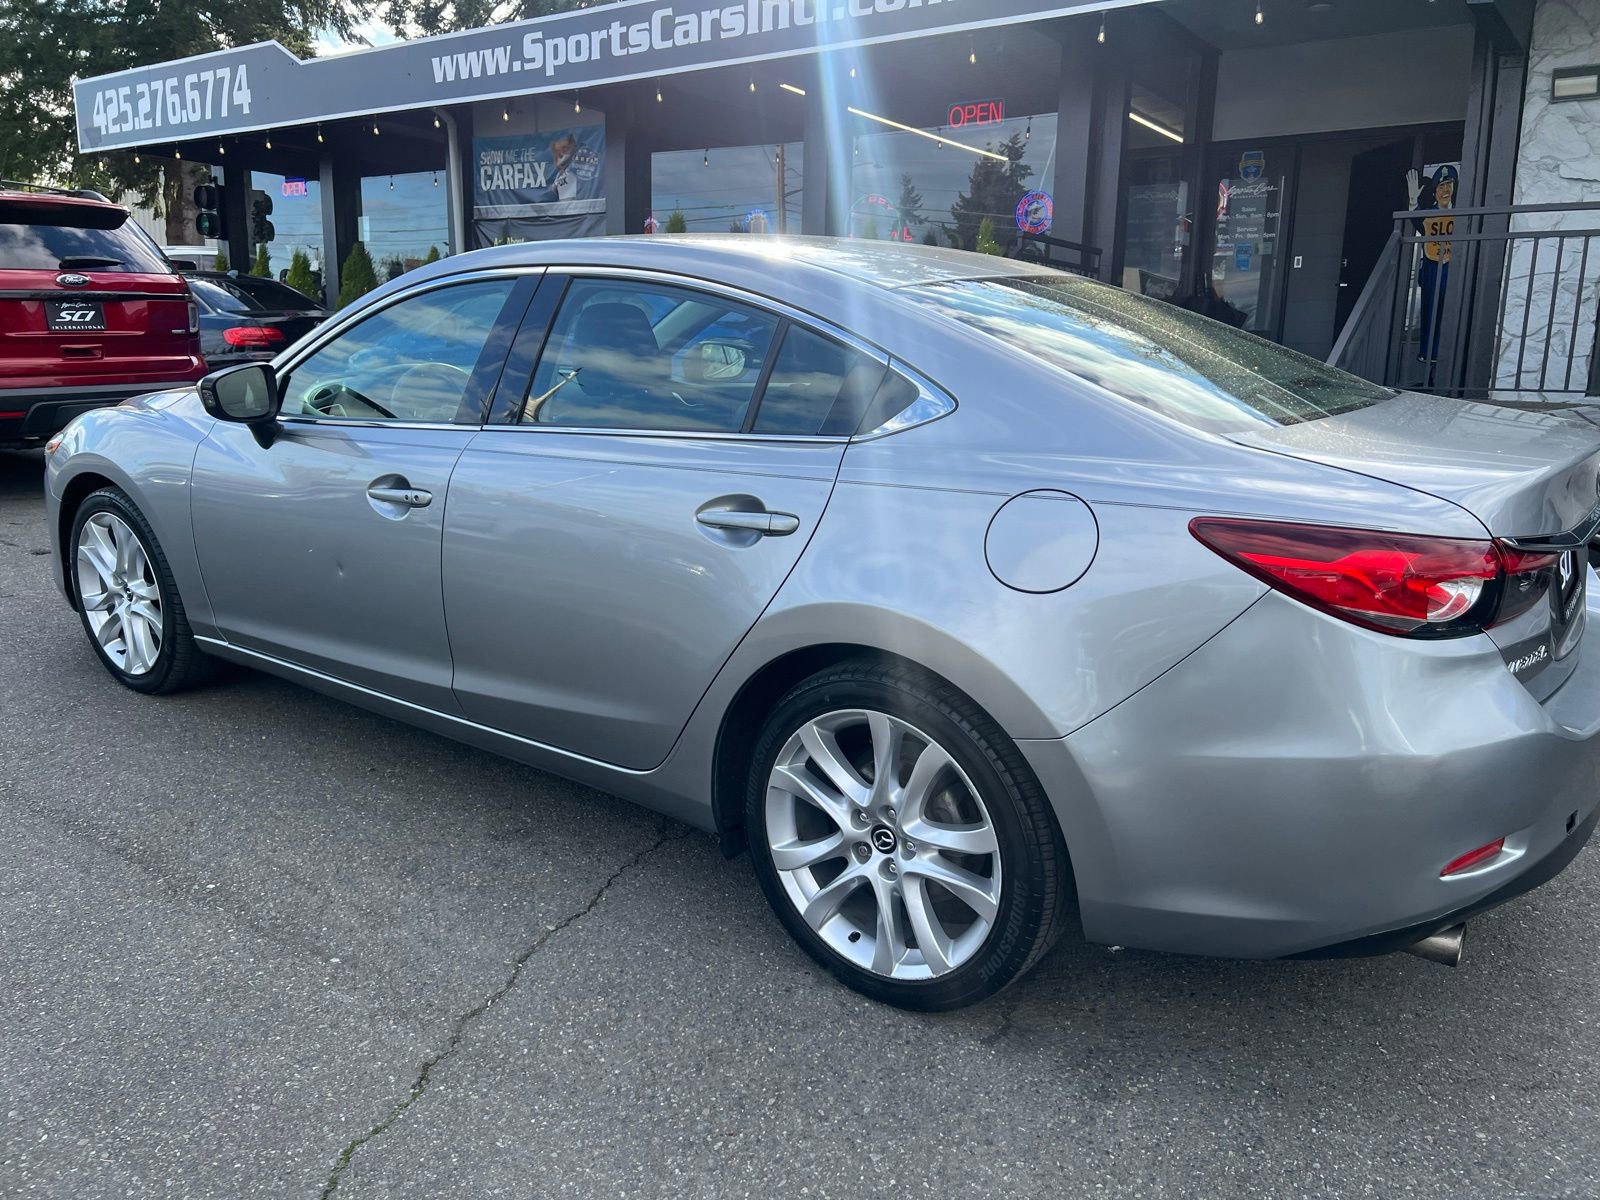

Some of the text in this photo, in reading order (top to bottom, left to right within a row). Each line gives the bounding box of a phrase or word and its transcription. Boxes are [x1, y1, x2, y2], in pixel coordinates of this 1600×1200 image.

[431, 0, 953, 83] www.SportsCarsIntl.c
[93, 64, 252, 136] 425.276.6774
[949, 102, 1003, 128] OPEN
[480, 147, 536, 165] SHOW ME THE
[481, 162, 547, 191] CARFAX
[282, 182, 304, 197] OPEN
[1430, 221, 1454, 236] SLO
[64, 275, 83, 284] Ford
[56, 310, 96, 322] SCI
